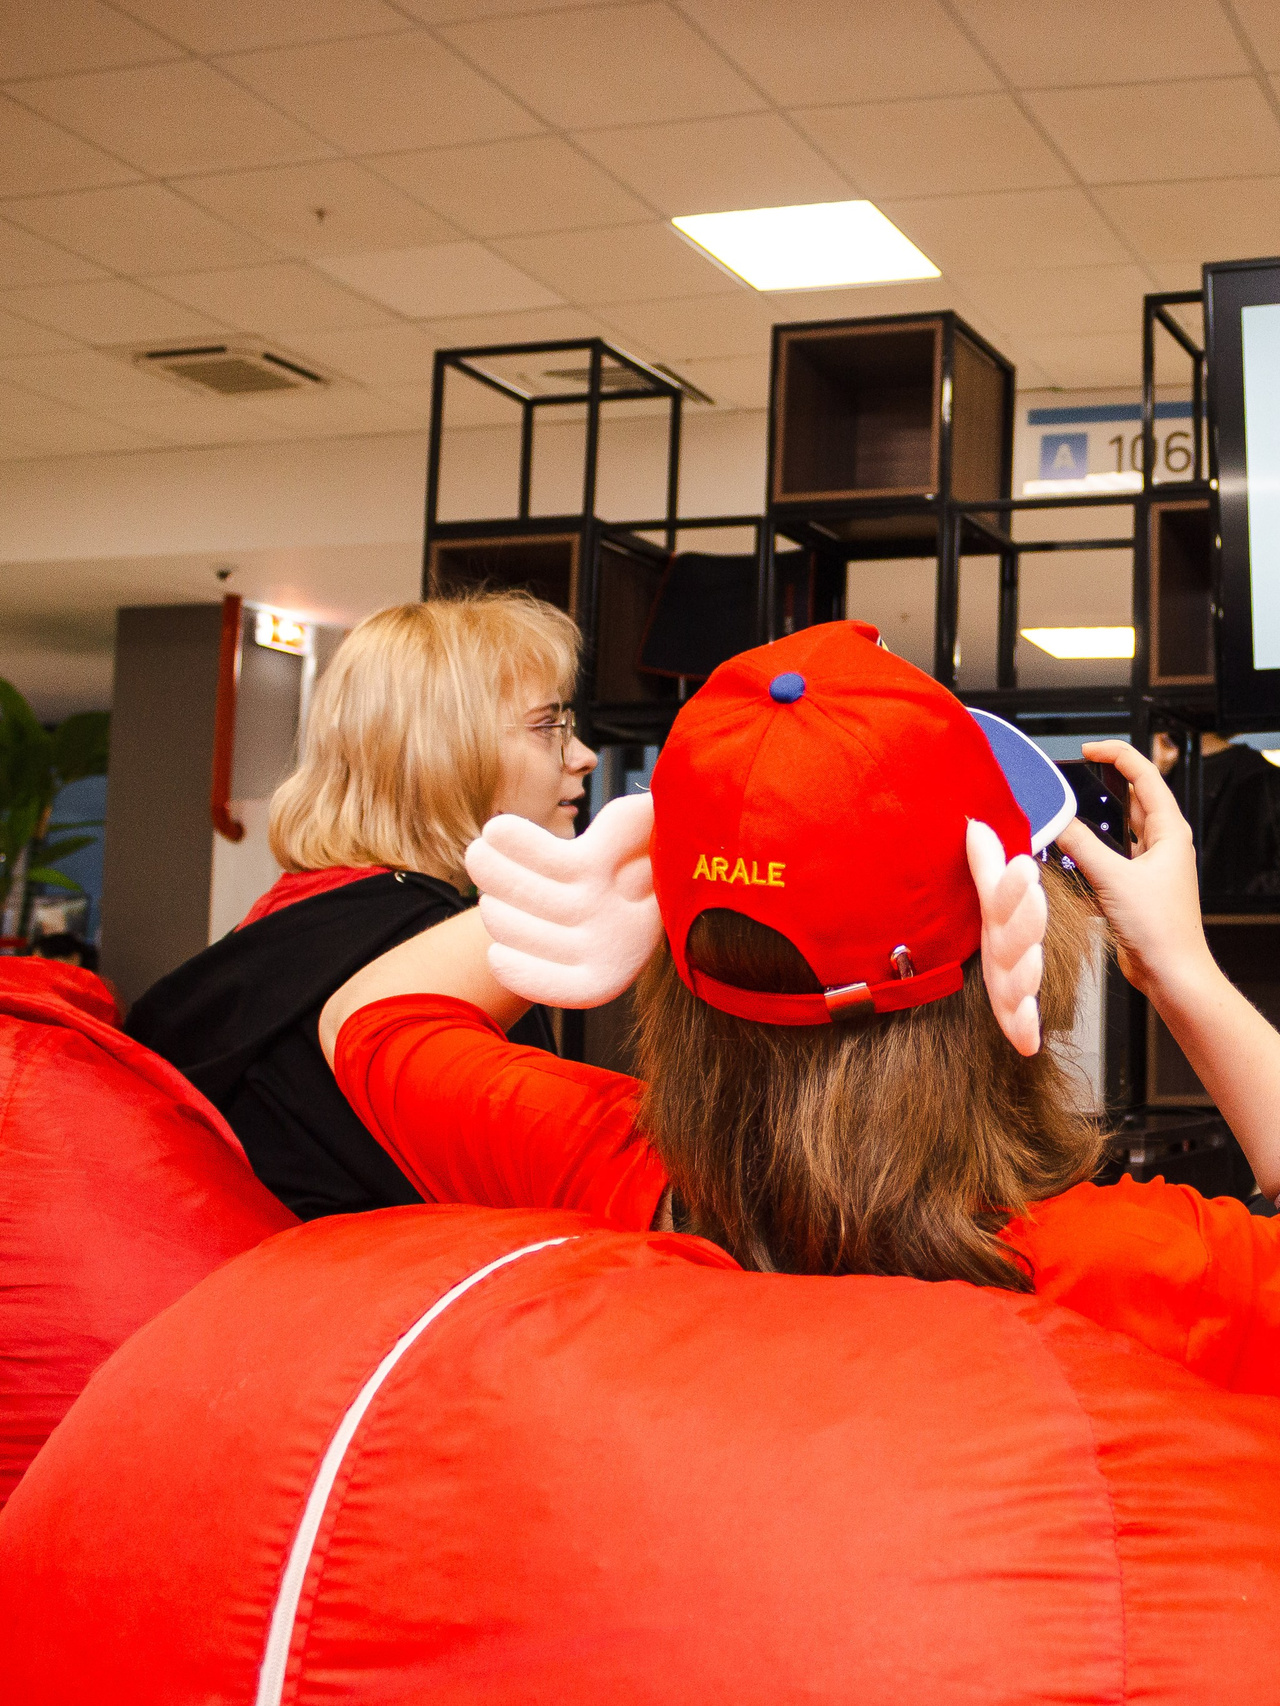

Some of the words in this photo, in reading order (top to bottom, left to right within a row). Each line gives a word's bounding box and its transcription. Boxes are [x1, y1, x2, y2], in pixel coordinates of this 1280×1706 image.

[1052, 442, 1077, 470] A
[1108, 431, 1192, 474] 106
[692, 854, 786, 888] ARALE
